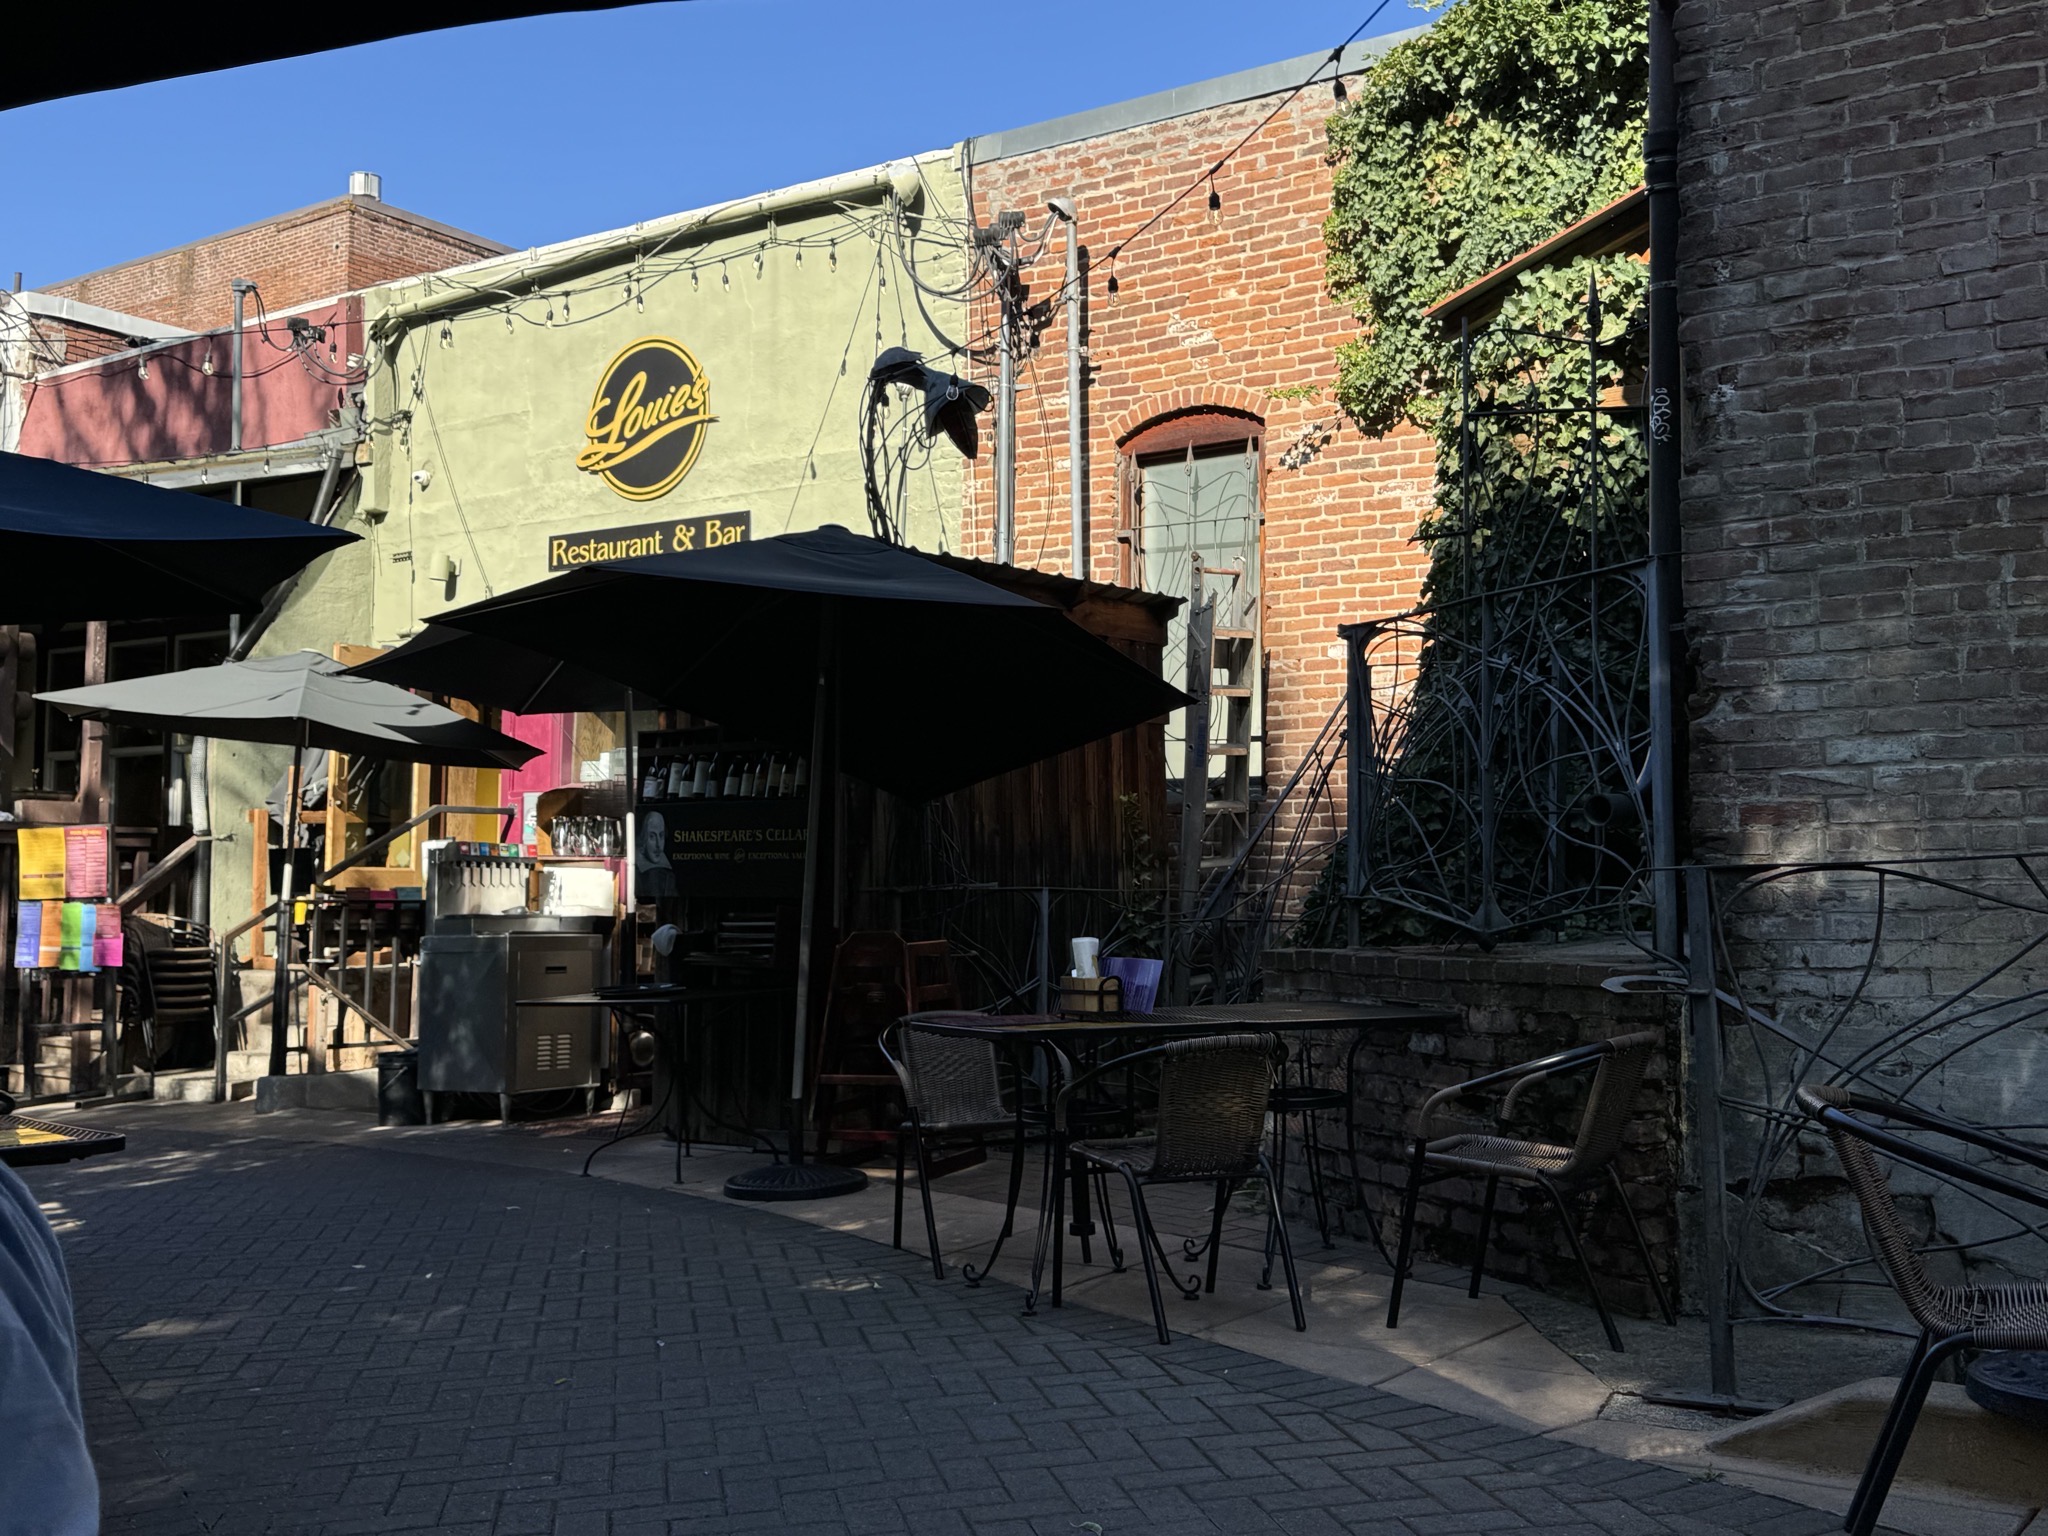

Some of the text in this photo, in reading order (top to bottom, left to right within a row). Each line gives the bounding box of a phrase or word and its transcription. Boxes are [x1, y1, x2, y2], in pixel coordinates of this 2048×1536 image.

[576, 364, 710, 468] Louie's
[552, 520, 746, 567] Restaurant & Bar
[674, 829, 763, 843] SHAKESPEARE'S
[672, 852, 713, 861] EXCEPTIONAL
